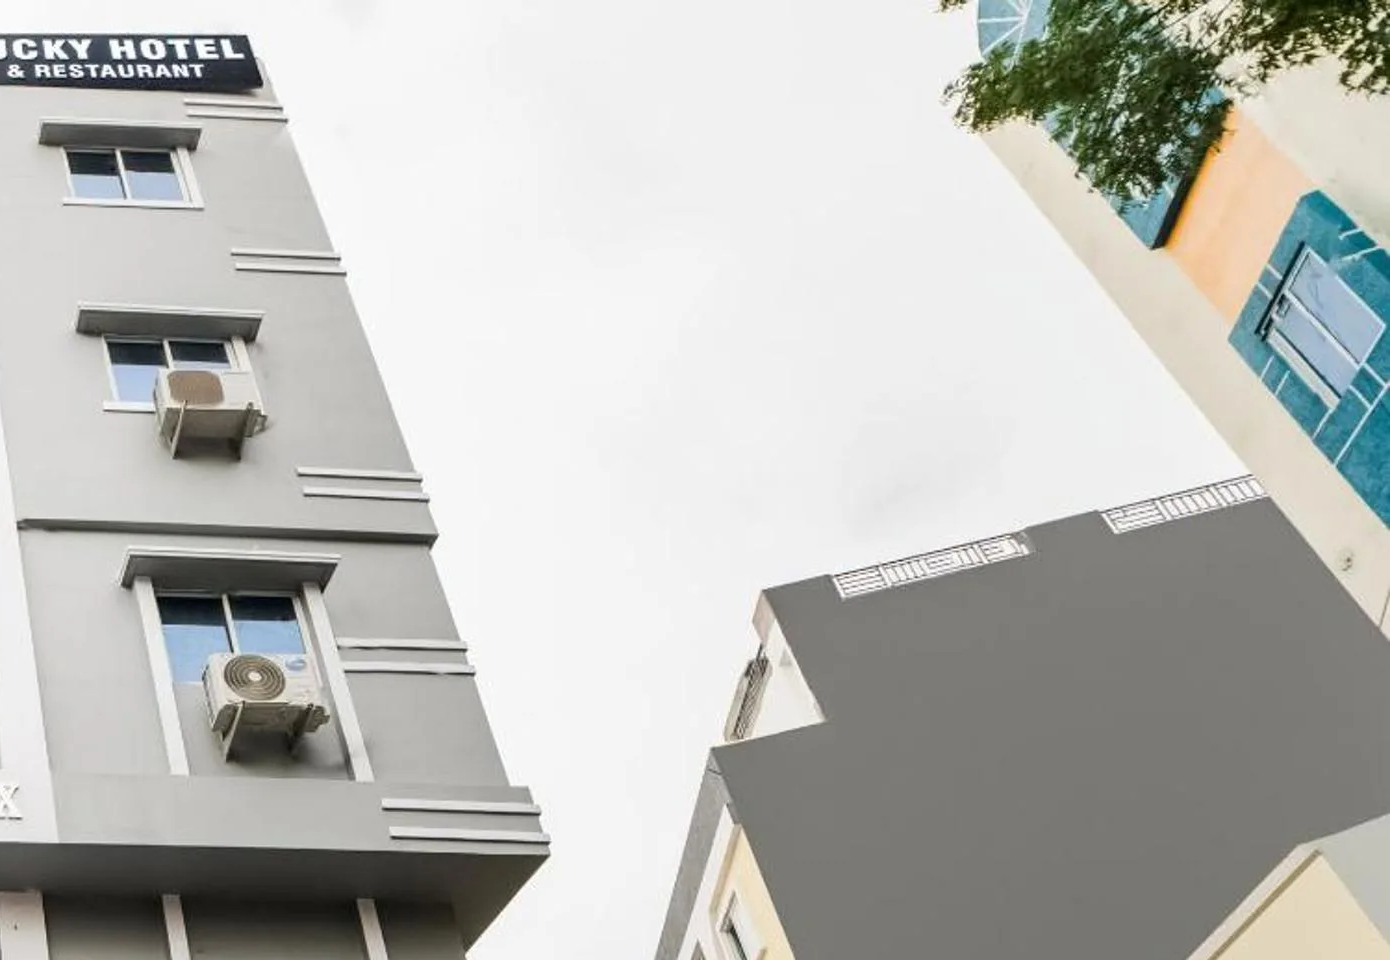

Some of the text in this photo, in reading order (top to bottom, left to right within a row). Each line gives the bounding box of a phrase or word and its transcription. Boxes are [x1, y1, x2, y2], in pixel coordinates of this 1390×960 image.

[109, 38, 245, 60] HOTEL
[7, 63, 204, 79] & RESTAURANT
